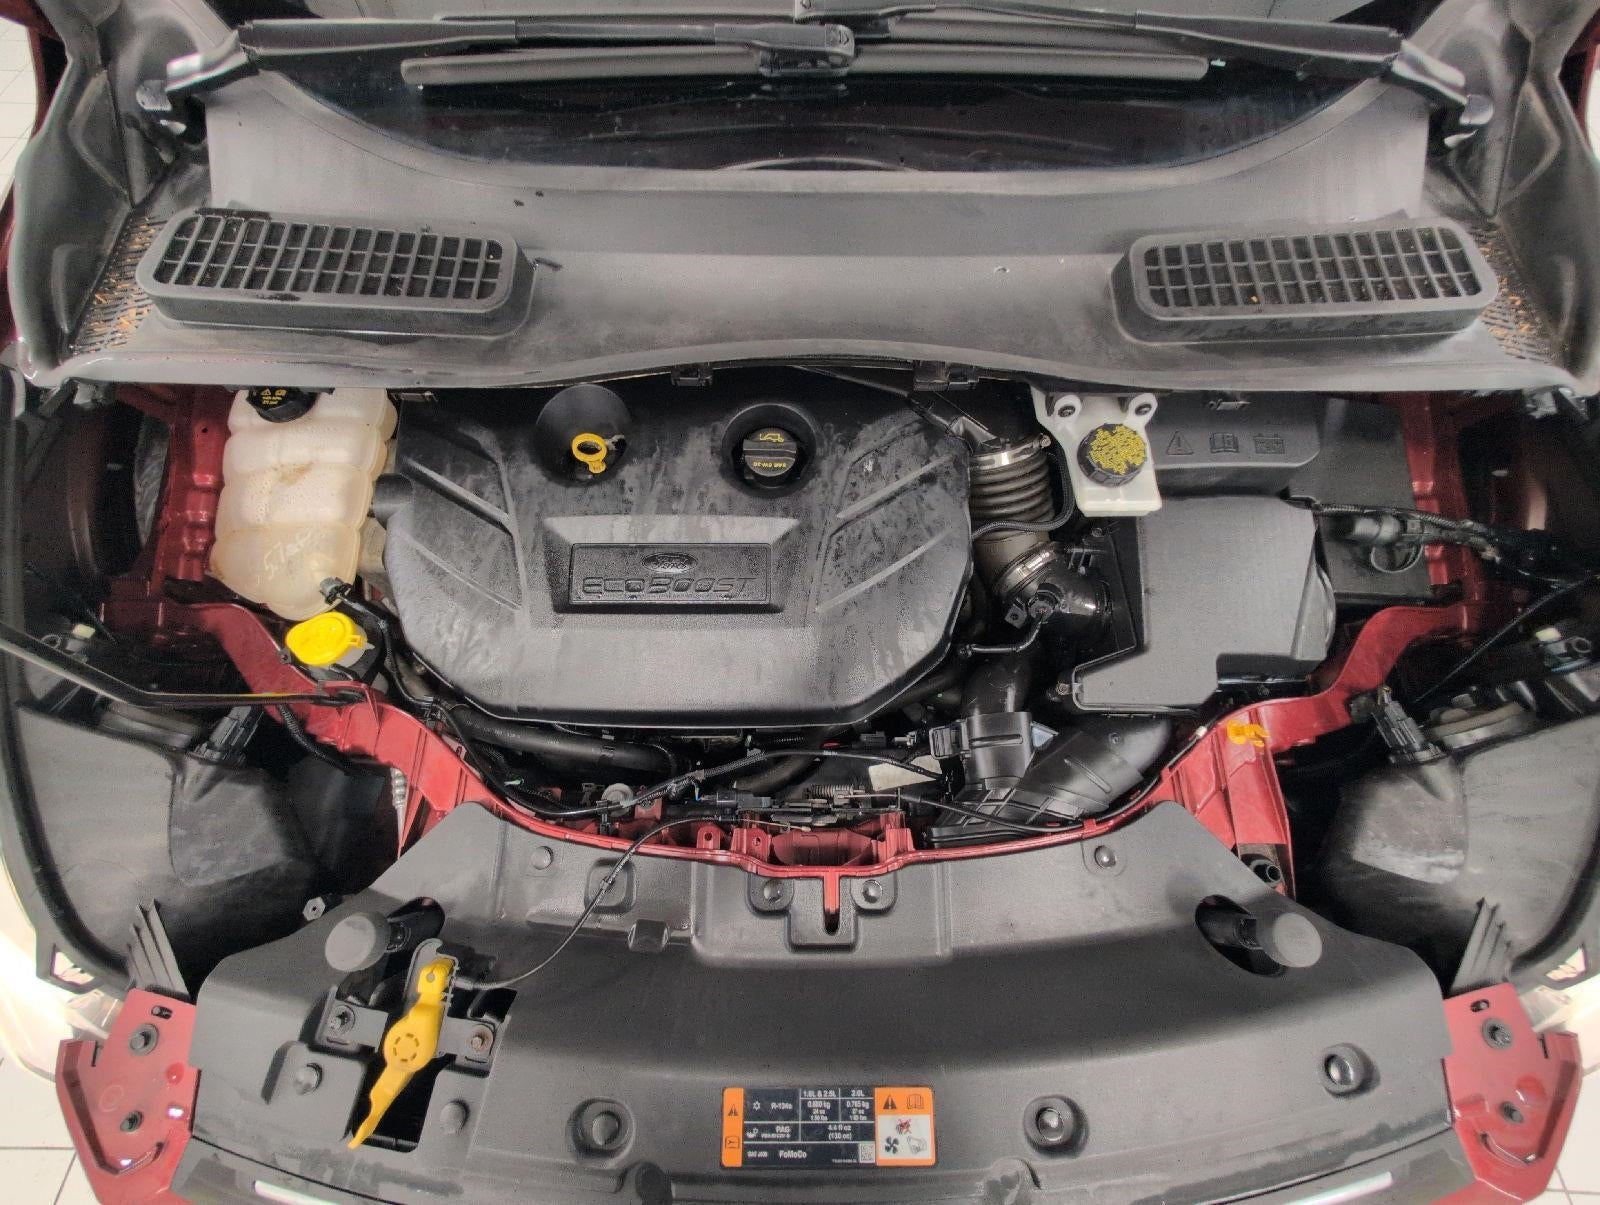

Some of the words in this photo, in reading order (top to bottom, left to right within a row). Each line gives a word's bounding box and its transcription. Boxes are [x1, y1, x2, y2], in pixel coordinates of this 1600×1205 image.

[582, 576, 757, 594] ECOBOOST
[851, 1089, 865, 1097] 2.0L
[775, 1125, 791, 1133] PAG
[778, 1150, 807, 1159] FoMoCo
